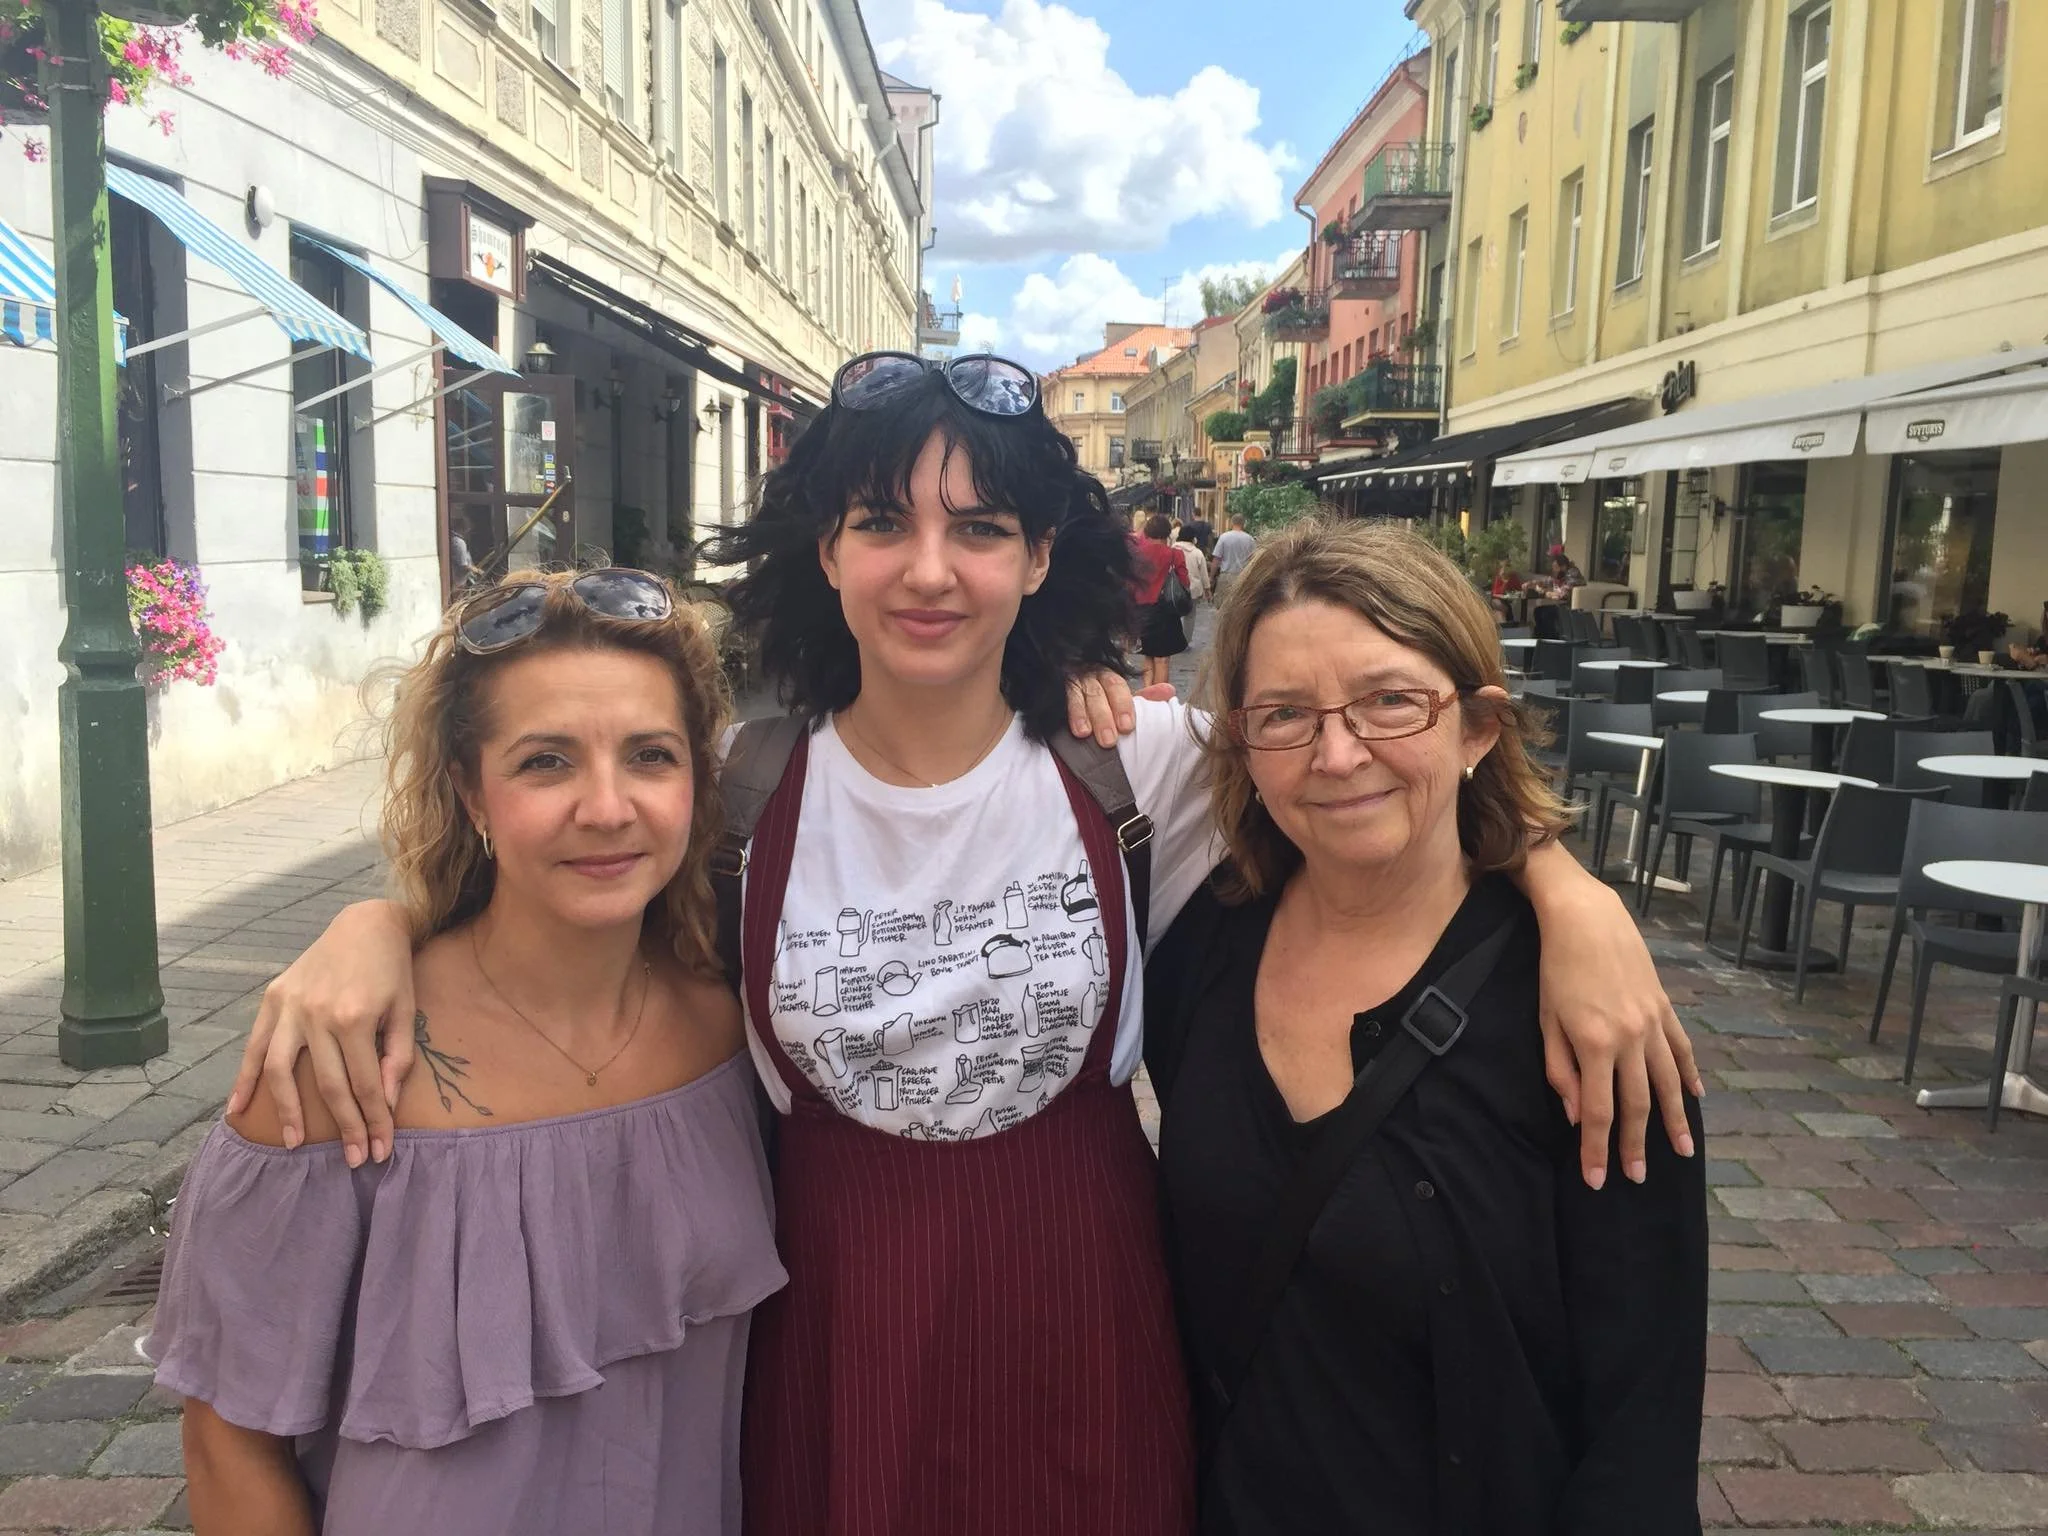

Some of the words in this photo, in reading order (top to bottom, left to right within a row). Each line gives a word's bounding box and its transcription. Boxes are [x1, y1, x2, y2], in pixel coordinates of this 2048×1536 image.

[954, 918, 994, 933] DECANTER
[811, 938, 827, 947] POT
[917, 958, 937, 968] LINO
[1033, 953, 1050, 963] TEA
[1033, 981, 1055, 991] TORD
[843, 1000, 876, 1013] PITCHER
[979, 998, 1000, 1008] ENZO
[981, 1006, 1000, 1016] MARI
